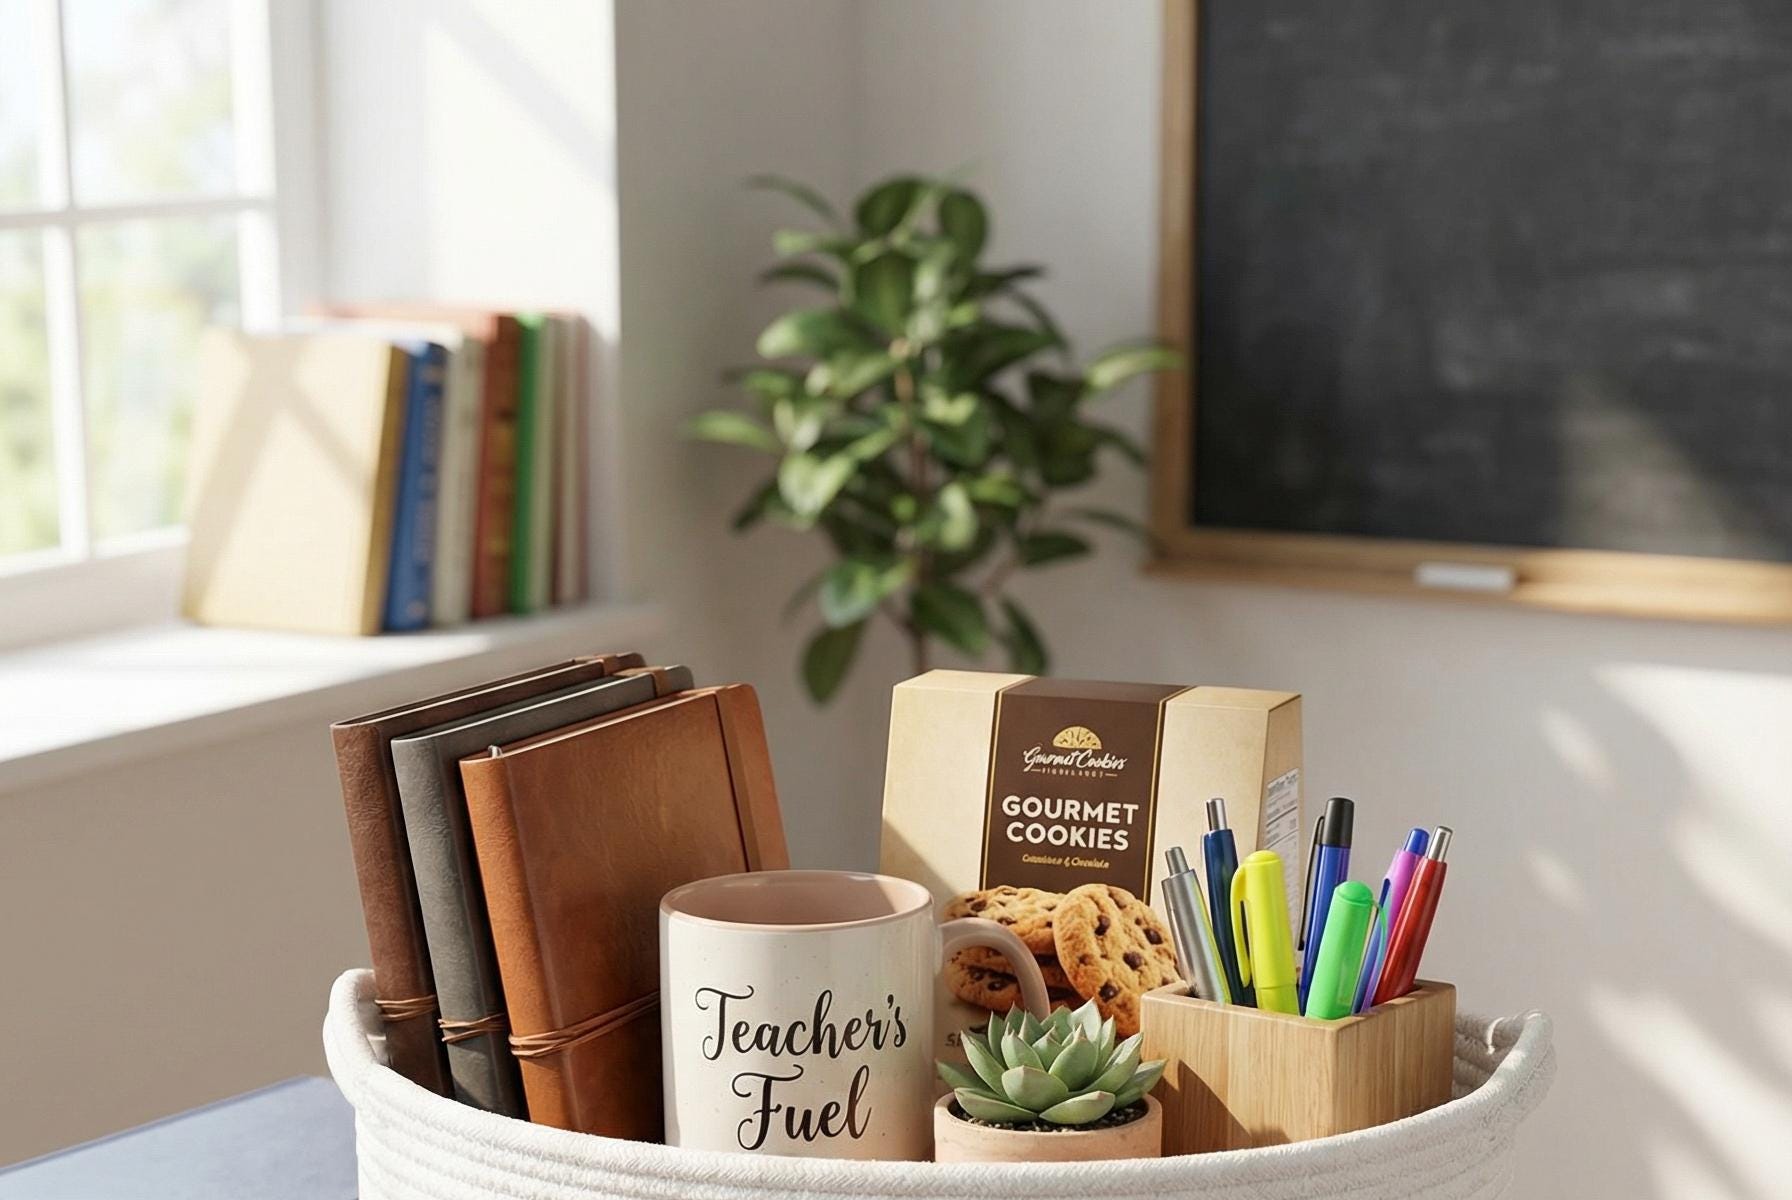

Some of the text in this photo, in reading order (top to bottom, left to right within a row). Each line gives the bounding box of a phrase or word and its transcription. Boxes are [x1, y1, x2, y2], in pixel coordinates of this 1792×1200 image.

[1002, 795, 1139, 825] GOURMET
[1006, 821, 1129, 851] COOKIES
[695, 984, 906, 1061] Teacher's
[732, 1064, 872, 1151] Fuel
